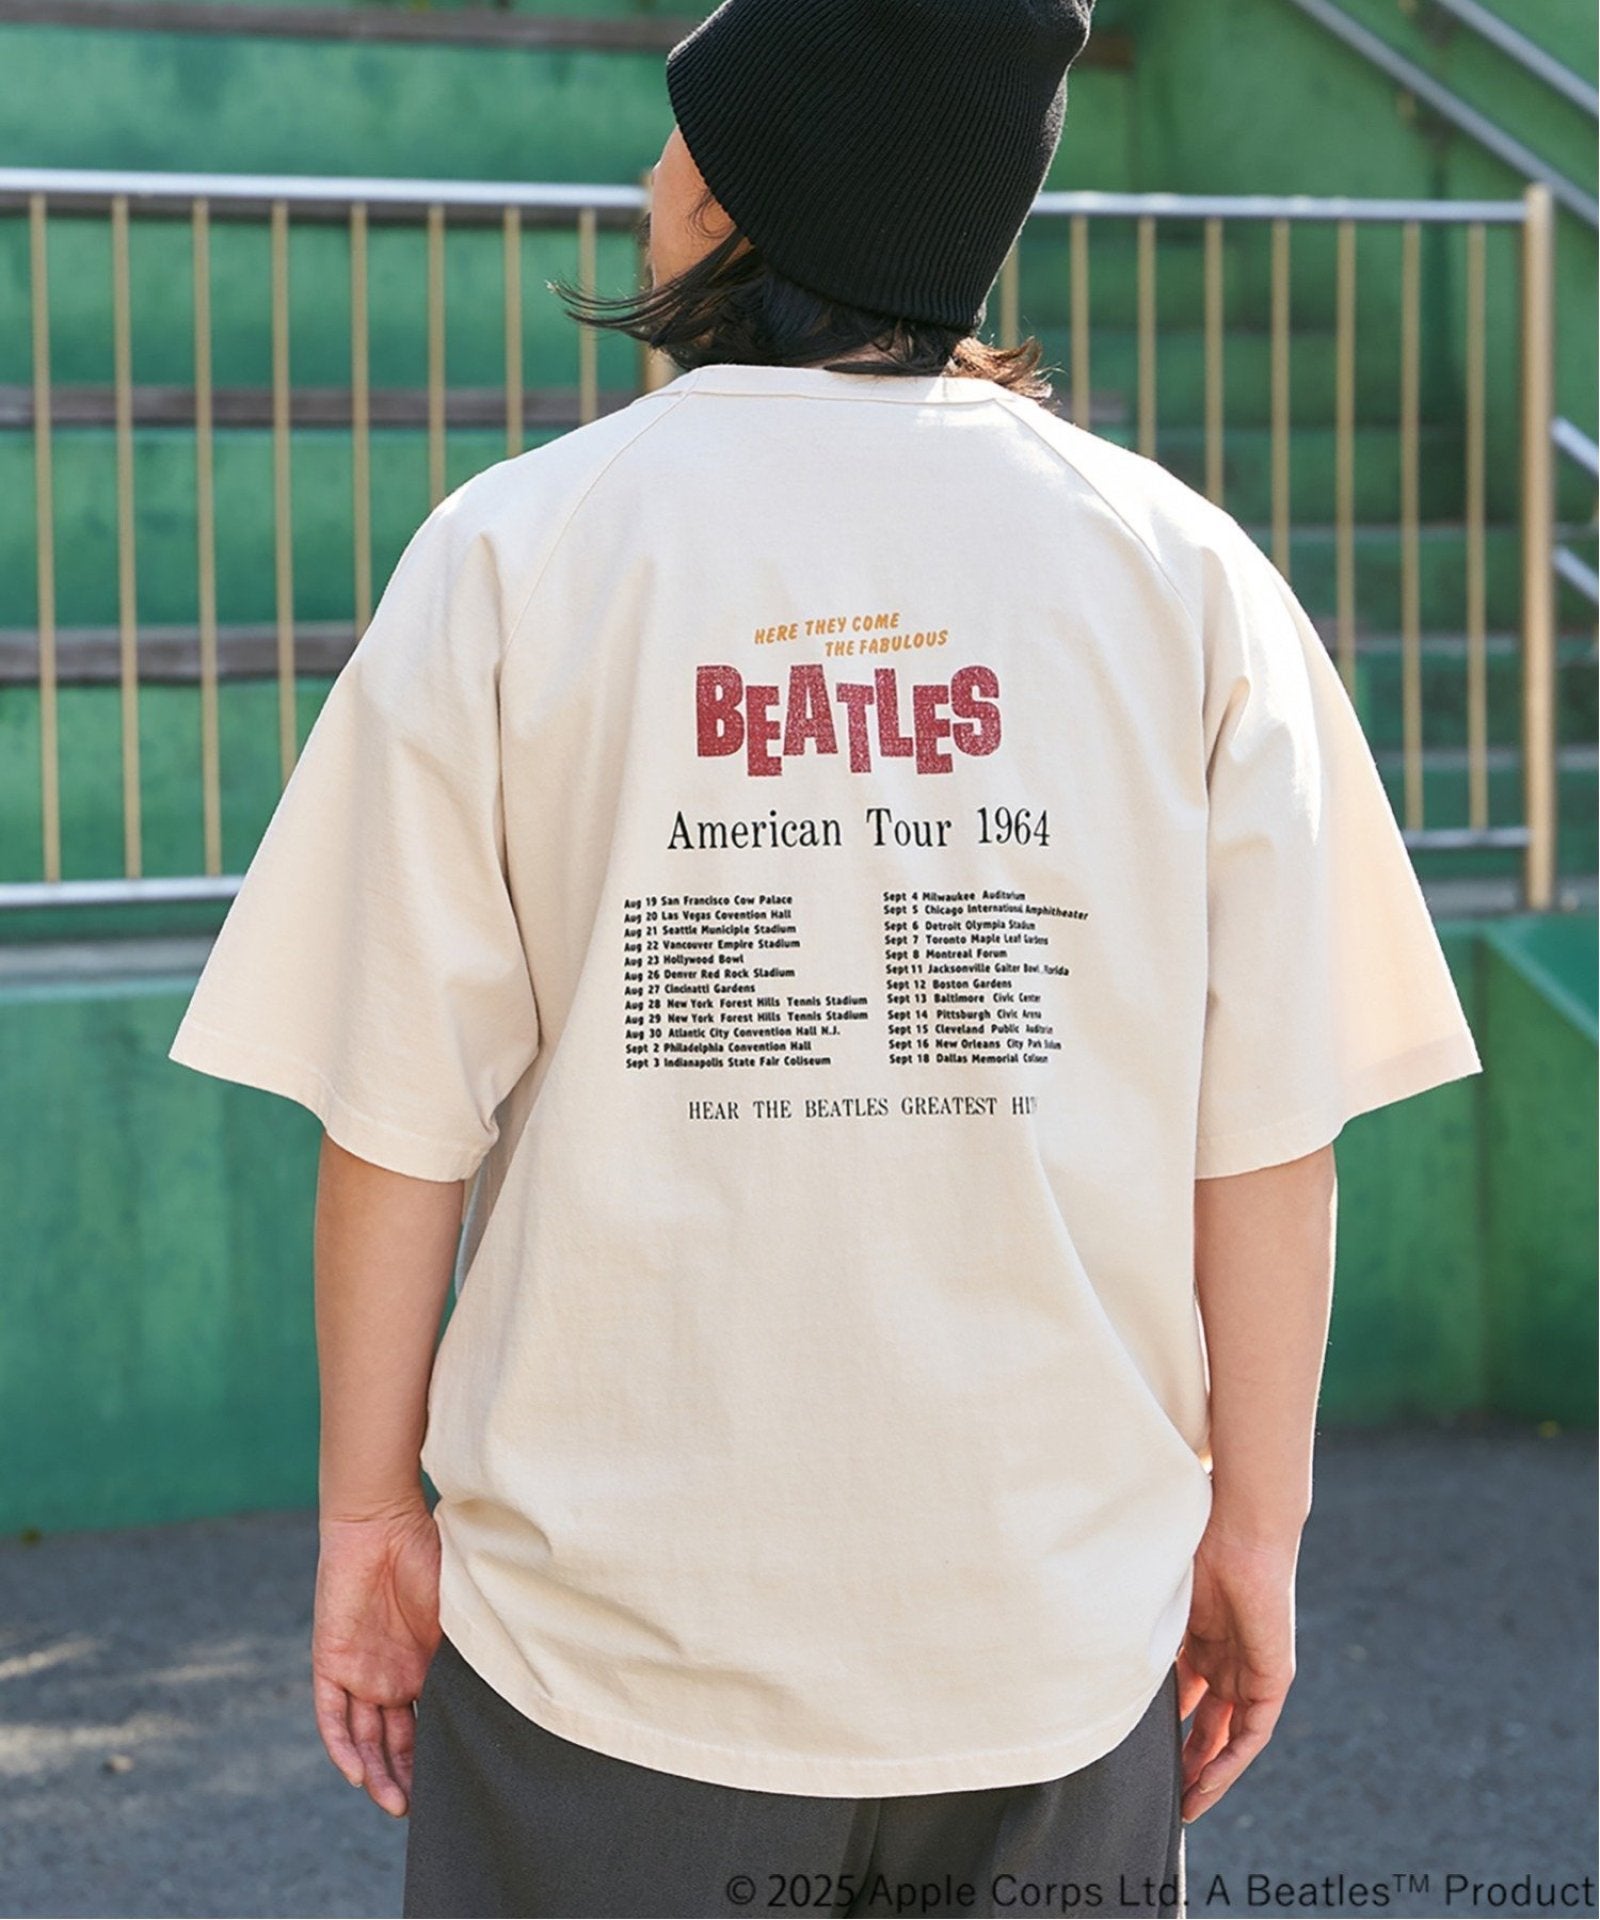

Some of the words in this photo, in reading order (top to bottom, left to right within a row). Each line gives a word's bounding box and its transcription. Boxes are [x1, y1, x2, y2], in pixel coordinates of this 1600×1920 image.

[754, 623, 798, 644] HERE
[805, 617, 847, 636] THEY
[852, 612, 900, 632] COME
[825, 641, 854, 657] THE
[859, 630, 949, 655] FABULOUS
[696, 664, 1002, 777] BEATLES
[667, 810, 842, 849] American
[866, 808, 952, 847] Tour
[977, 807, 1051, 847] 1964
[624, 899, 642, 909] Aug
[646, 896, 657, 907] 19
[661, 896, 680, 906] San
[683, 895, 730, 906] Francisco
[734, 895, 755, 905] Cow
[759, 895, 792, 905] Palace
[883, 892, 906, 902] Sept
[912, 892, 918, 901] 4
[922, 891, 975, 901] Milwaukee
[624, 914, 642, 924] Aug
[646, 911, 658, 921] 20
[661, 911, 679, 921] Las
[683, 910, 711, 921] Vegas
[715, 910, 767, 920] Covention
[771, 910, 791, 919] Hall
[883, 906, 907, 916] Sept
[912, 906, 918, 914] 5
[925, 905, 964, 916] Chicago
[624, 928, 642, 938] Aug
[646, 926, 657, 936] 21
[662, 925, 697, 935] Seattle
[701, 924, 750, 936] Municiple
[754, 924, 796, 934] Stadium
[884, 921, 907, 932] Sept
[912, 921, 919, 931] 6
[925, 921, 962, 931] Detroit
[966, 921, 1005, 931] Olympia
[624, 942, 642, 953] Aug
[647, 940, 659, 950] 22
[663, 940, 713, 950] Vancouver
[718, 939, 754, 950] Empire
[758, 939, 800, 949] Stadium
[885, 935, 908, 946] Sept
[913, 935, 919, 944] 7
[926, 934, 966, 944] Toronto
[971, 934, 1000, 945] Maple
[624, 957, 642, 967] Aug
[647, 955, 659, 965] 23
[663, 954, 714, 966] Hollywood
[718, 954, 744, 964] Bowl
[885, 950, 908, 961] Sept
[913, 950, 920, 959] 8
[926, 949, 972, 959] Montreal
[977, 949, 1007, 958] Forum
[624, 972, 643, 982] Aug
[647, 969, 660, 980] 26
[664, 969, 697, 979] Denver
[701, 969, 720, 979] Red
[724, 968, 749, 979] Rock
[886, 964, 909, 975] Sept
[911, 964, 922, 974] 11
[928, 964, 990, 974] Jacksonville
[624, 986, 643, 996] Aug
[648, 984, 660, 995] 27
[713, 983, 756, 994] Gardens
[886, 980, 910, 990] Sept
[914, 980, 926, 989] 12
[932, 980, 969, 989] Boston
[973, 979, 1012, 989] Gardens
[625, 1000, 643, 1011] Aug
[648, 999, 661, 1009] 28
[667, 999, 688, 1008] New
[691, 998, 713, 1009] York
[720, 998, 753, 1008] Forest
[757, 997, 780, 1007] Hills
[787, 996, 821, 1007] Tennis
[825, 996, 868, 1006] Stadium
[887, 994, 910, 1005] Sept
[915, 994, 927, 1003] 13
[934, 994, 984, 1003] Baltimore
[993, 993, 1014, 1003] Civic
[625, 1015, 644, 1026] Aug
[648, 1013, 661, 1024] 29
[668, 1013, 688, 1023] New
[691, 1013, 714, 1023] York
[720, 1013, 753, 1023] Forest
[757, 1012, 781, 1022] Hills
[787, 1011, 822, 1022] Tennis
[826, 1010, 868, 1021] Stadium
[887, 1010, 911, 1021] Sept
[916, 1010, 928, 1019] 14
[936, 1010, 991, 1021] Pittsburgh
[997, 1009, 1017, 1019] Civic
[625, 1029, 644, 1040] Aug
[649, 1028, 662, 1038] 30
[668, 1028, 706, 1038] Atlantic
[709, 1028, 729, 1039] City
[733, 1026, 792, 1038] Convention
[796, 1026, 817, 1036] Hall
[888, 1025, 911, 1036] Sept
[917, 1025, 928, 1034] 15
[935, 1025, 984, 1034] Cleveland
[991, 1024, 1019, 1034] Public
[626, 1044, 648, 1055] Sept
[653, 1043, 659, 1053] 2
[664, 1042, 724, 1053] Philadelphia
[728, 1041, 786, 1053] Convention
[790, 1041, 812, 1051] Hall
[889, 1039, 912, 1050] Sept
[917, 1039, 929, 1049] 16
[936, 1039, 958, 1049] New
[961, 1039, 1001, 1048] Orleans
[1007, 1039, 1023, 1050] City
[626, 1058, 649, 1069] Sept
[653, 1057, 660, 1068] 3
[664, 1057, 724, 1069] Indianapolis
[727, 1057, 755, 1068] State
[759, 1056, 780, 1066] Fair
[784, 1056, 831, 1066] Coliseum
[889, 1054, 912, 1065] Sept
[918, 1054, 930, 1063] 18
[936, 1054, 968, 1063] Dallas
[972, 1053, 1019, 1063] Memorial
[689, 1101, 740, 1120] HEAR
[753, 1100, 792, 1119] THE
[805, 1099, 889, 1118] BEATLES
[901, 1096, 998, 1116] GREATEST
